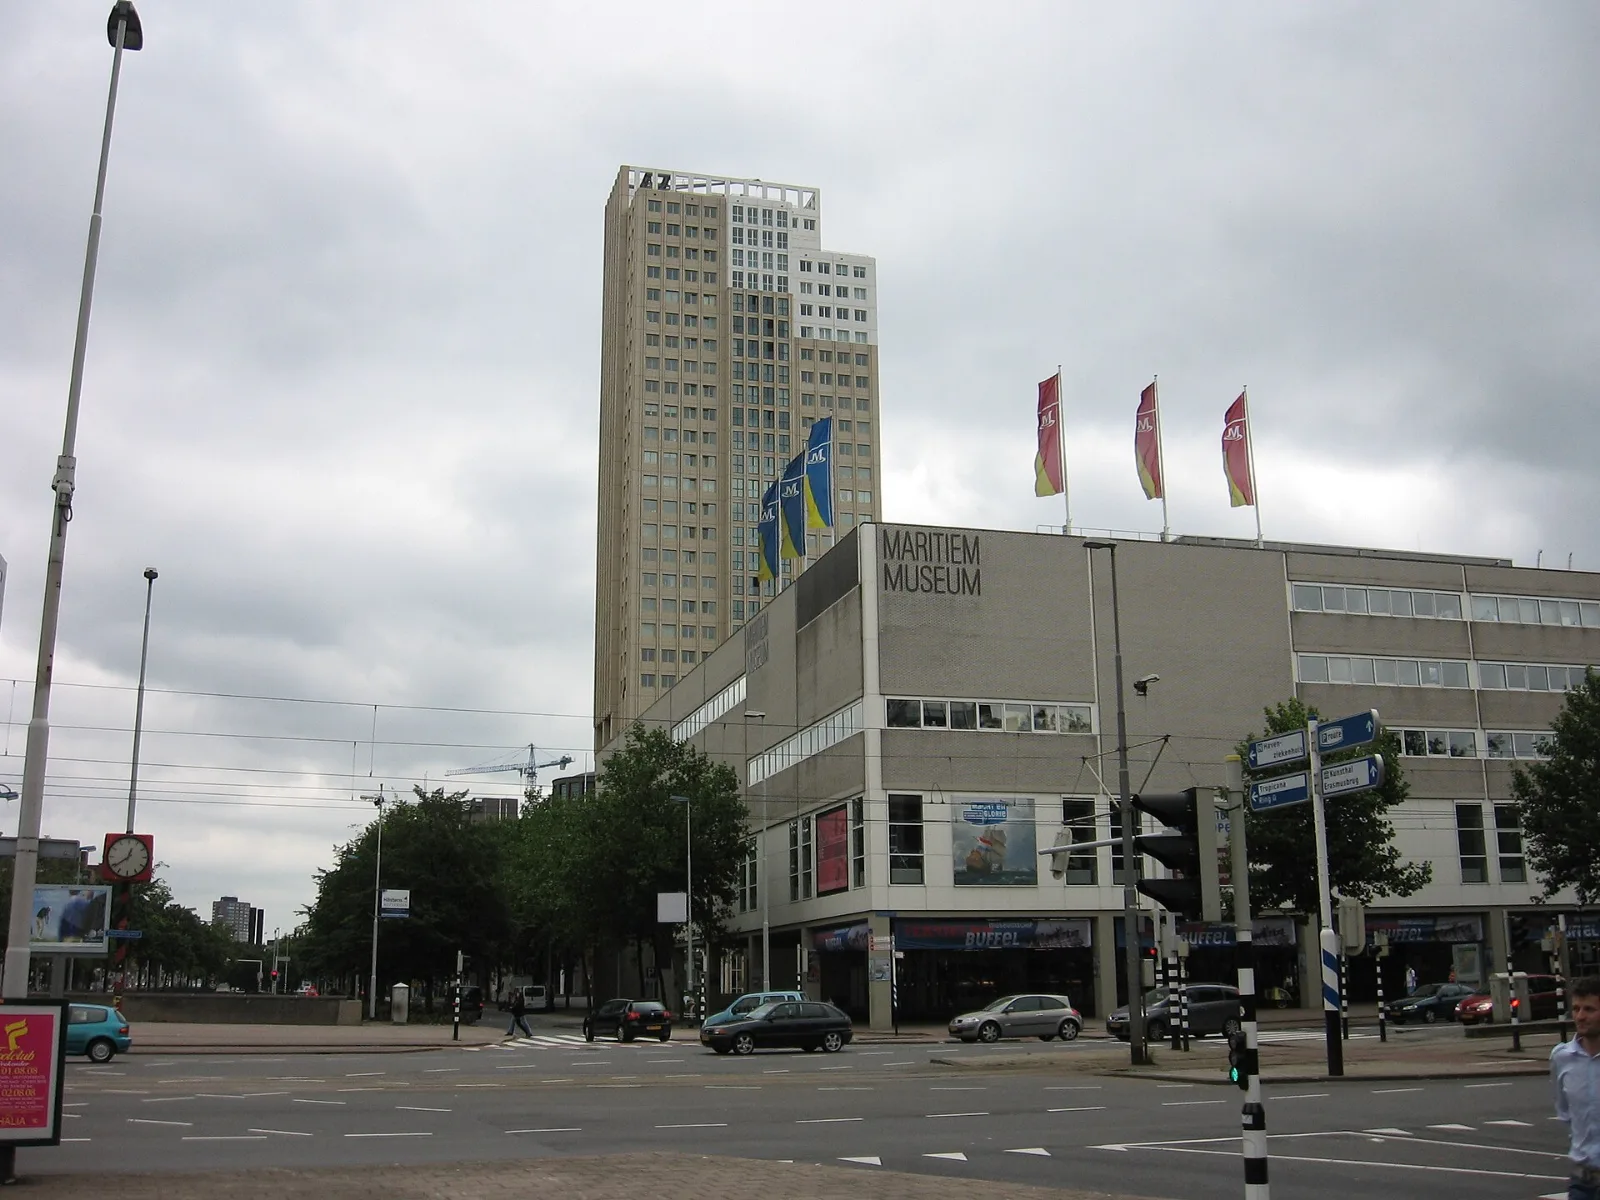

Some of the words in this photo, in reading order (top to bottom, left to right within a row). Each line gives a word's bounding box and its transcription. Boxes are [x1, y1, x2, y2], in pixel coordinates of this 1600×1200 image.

[883, 529, 980, 565] MARITIEM
[884, 564, 981, 596] MUSEUM
[1328, 731, 1342, 740] route
[1330, 765, 1354, 777] Kunsthal
[1259, 782, 1287, 793] Tropicana
[1324, 777, 1359, 790] Erasmusbrug
